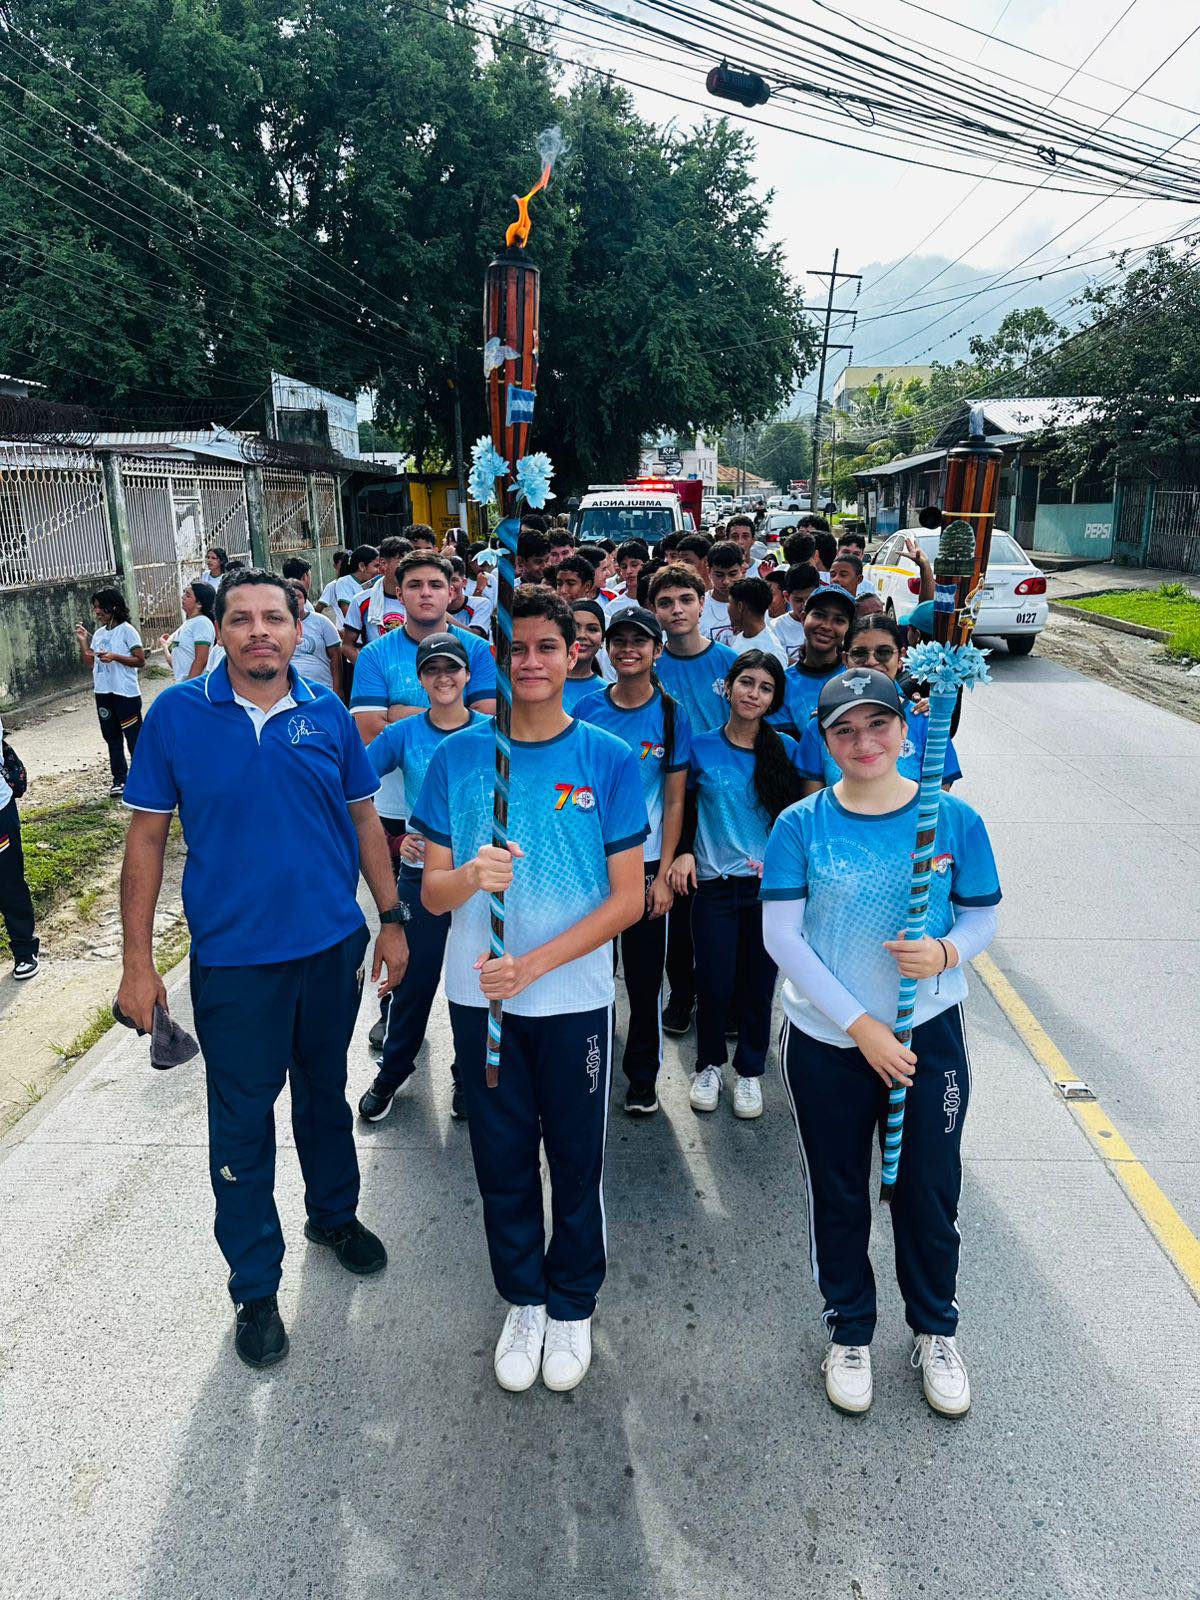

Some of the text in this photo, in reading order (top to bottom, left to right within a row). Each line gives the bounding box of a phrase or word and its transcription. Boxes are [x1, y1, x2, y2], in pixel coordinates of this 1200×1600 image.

[1083, 523, 1112, 539] PEPSI
[1016, 612, 1037, 624] 0127
[944, 1069, 961, 1134] ISJ
